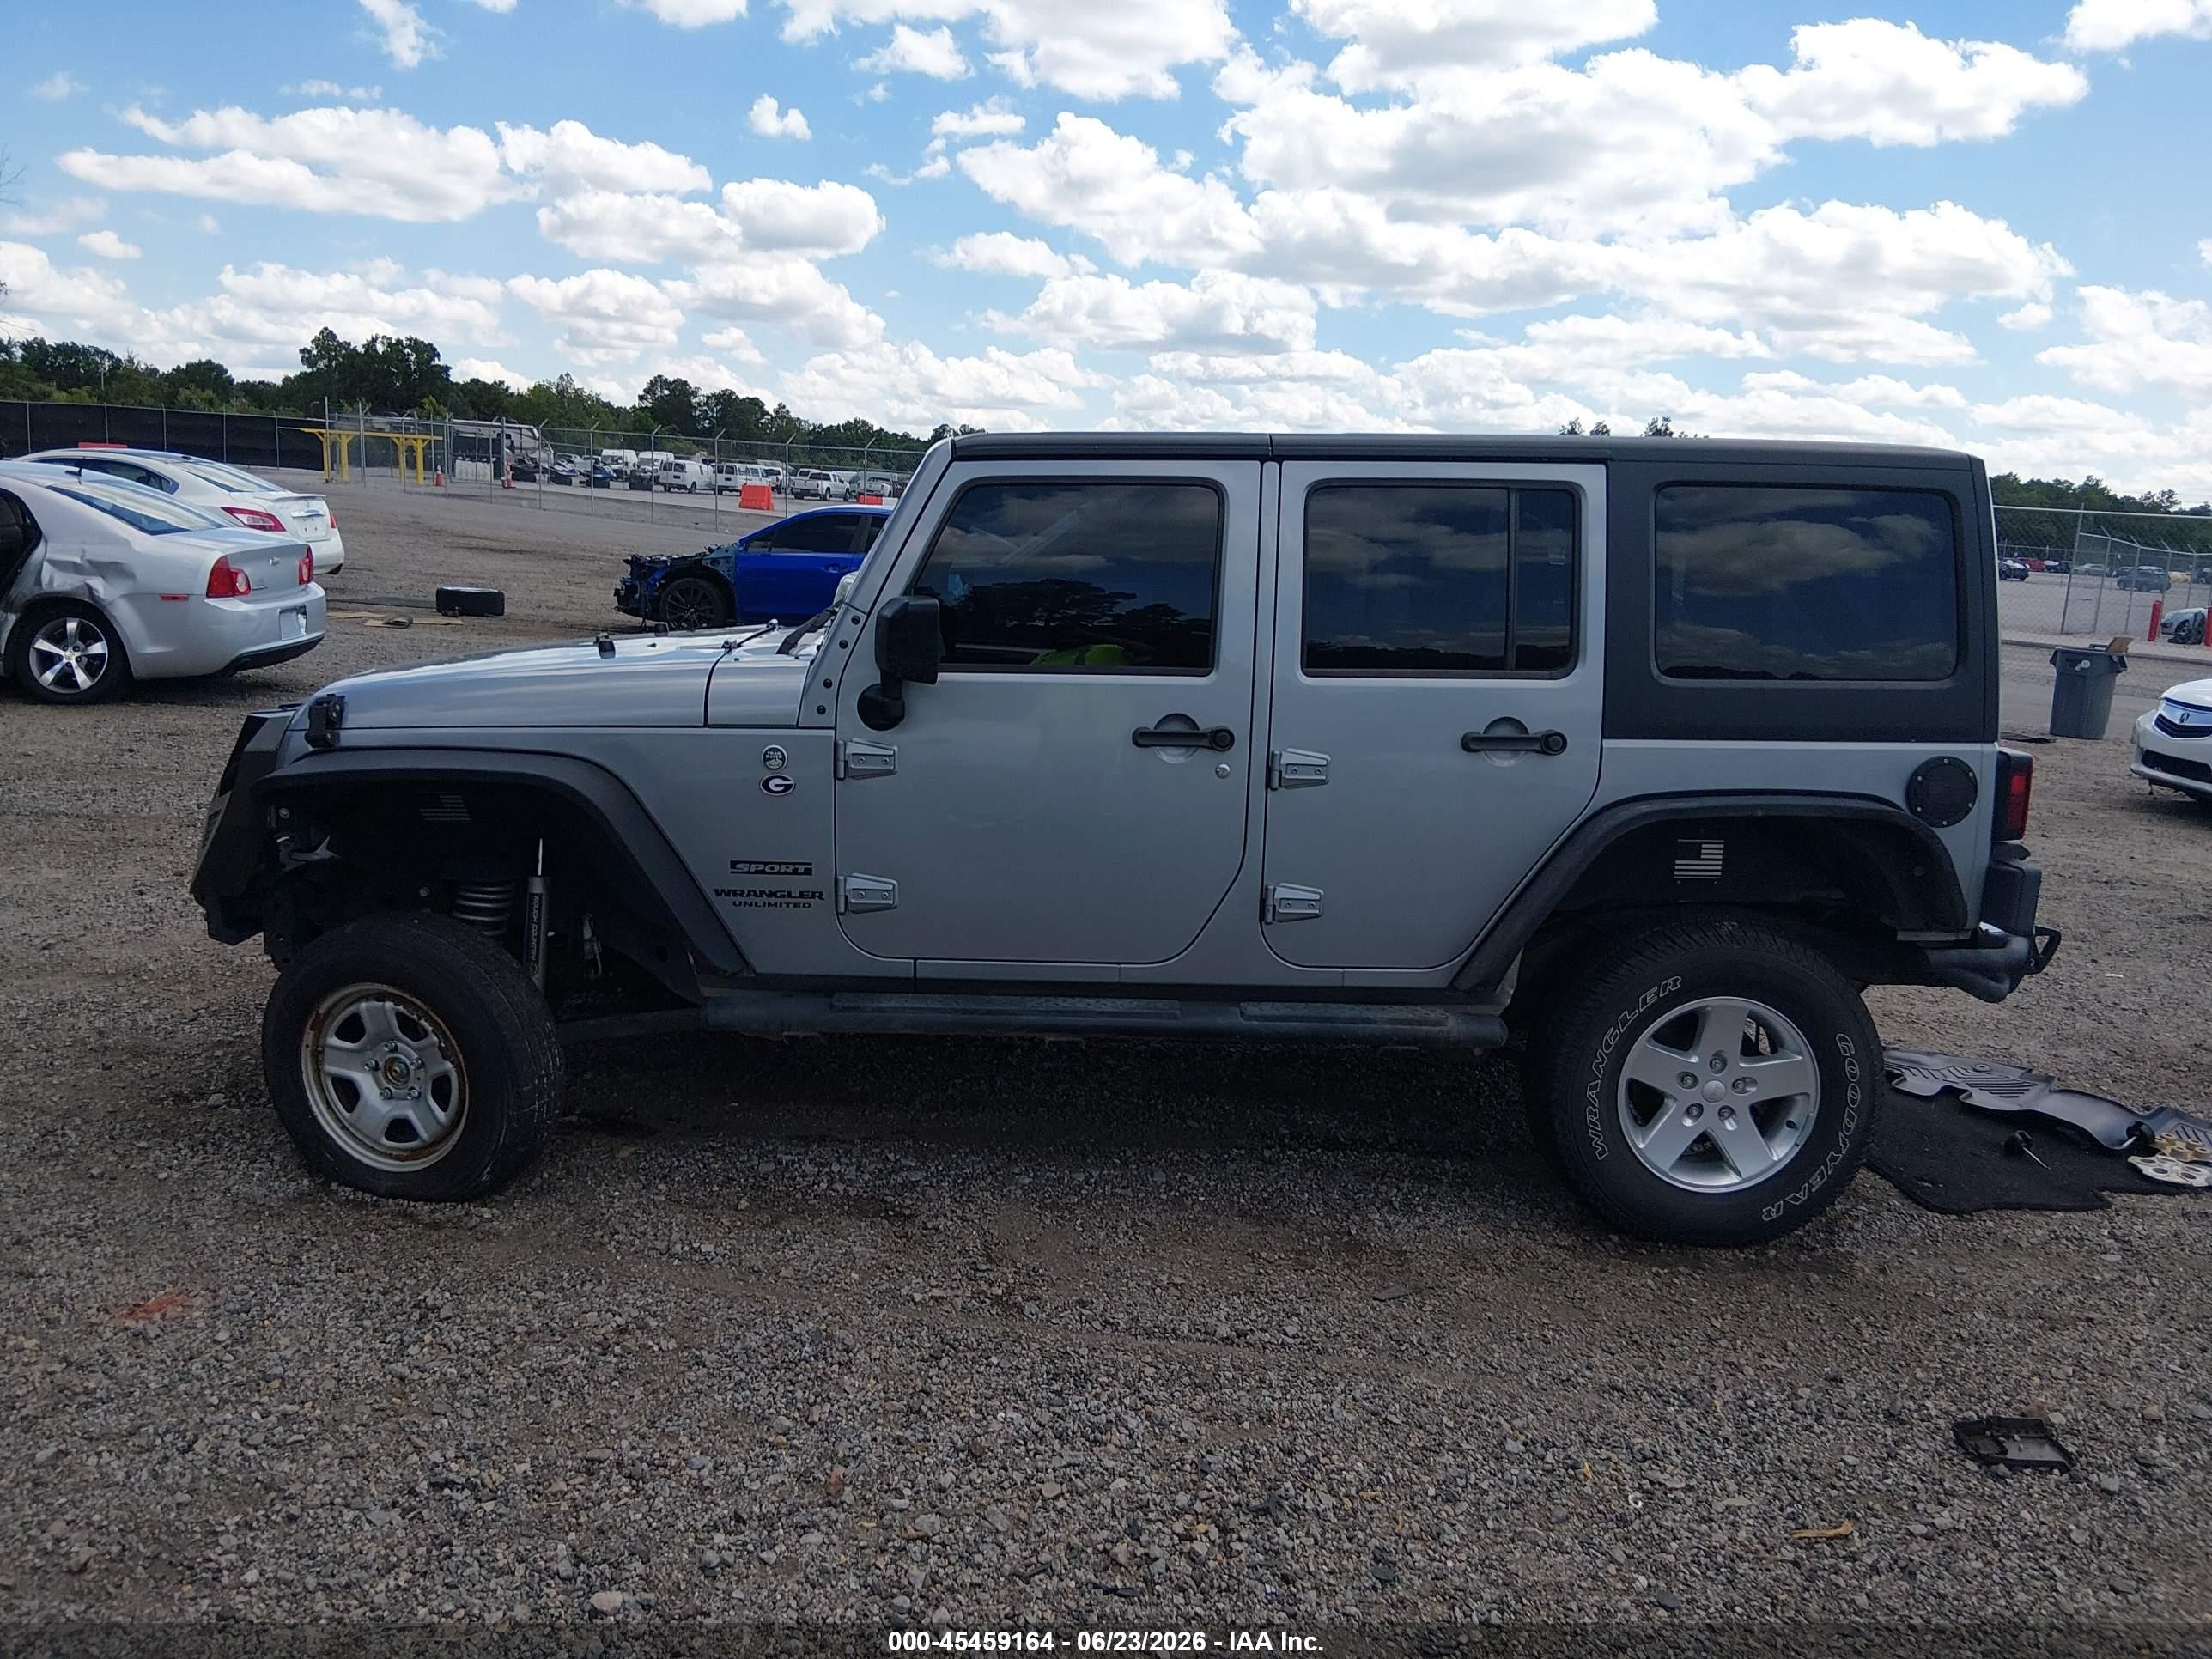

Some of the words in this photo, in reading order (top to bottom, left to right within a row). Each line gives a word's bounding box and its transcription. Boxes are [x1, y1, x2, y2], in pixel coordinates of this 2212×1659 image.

[731, 861, 812, 874] SPORT
[714, 888, 825, 901] WRANGLER
[732, 901, 812, 909] UNLIMITED
[1586, 975, 1682, 1160] WRANGLER
[1762, 1033, 1860, 1222] GOODYEAR
